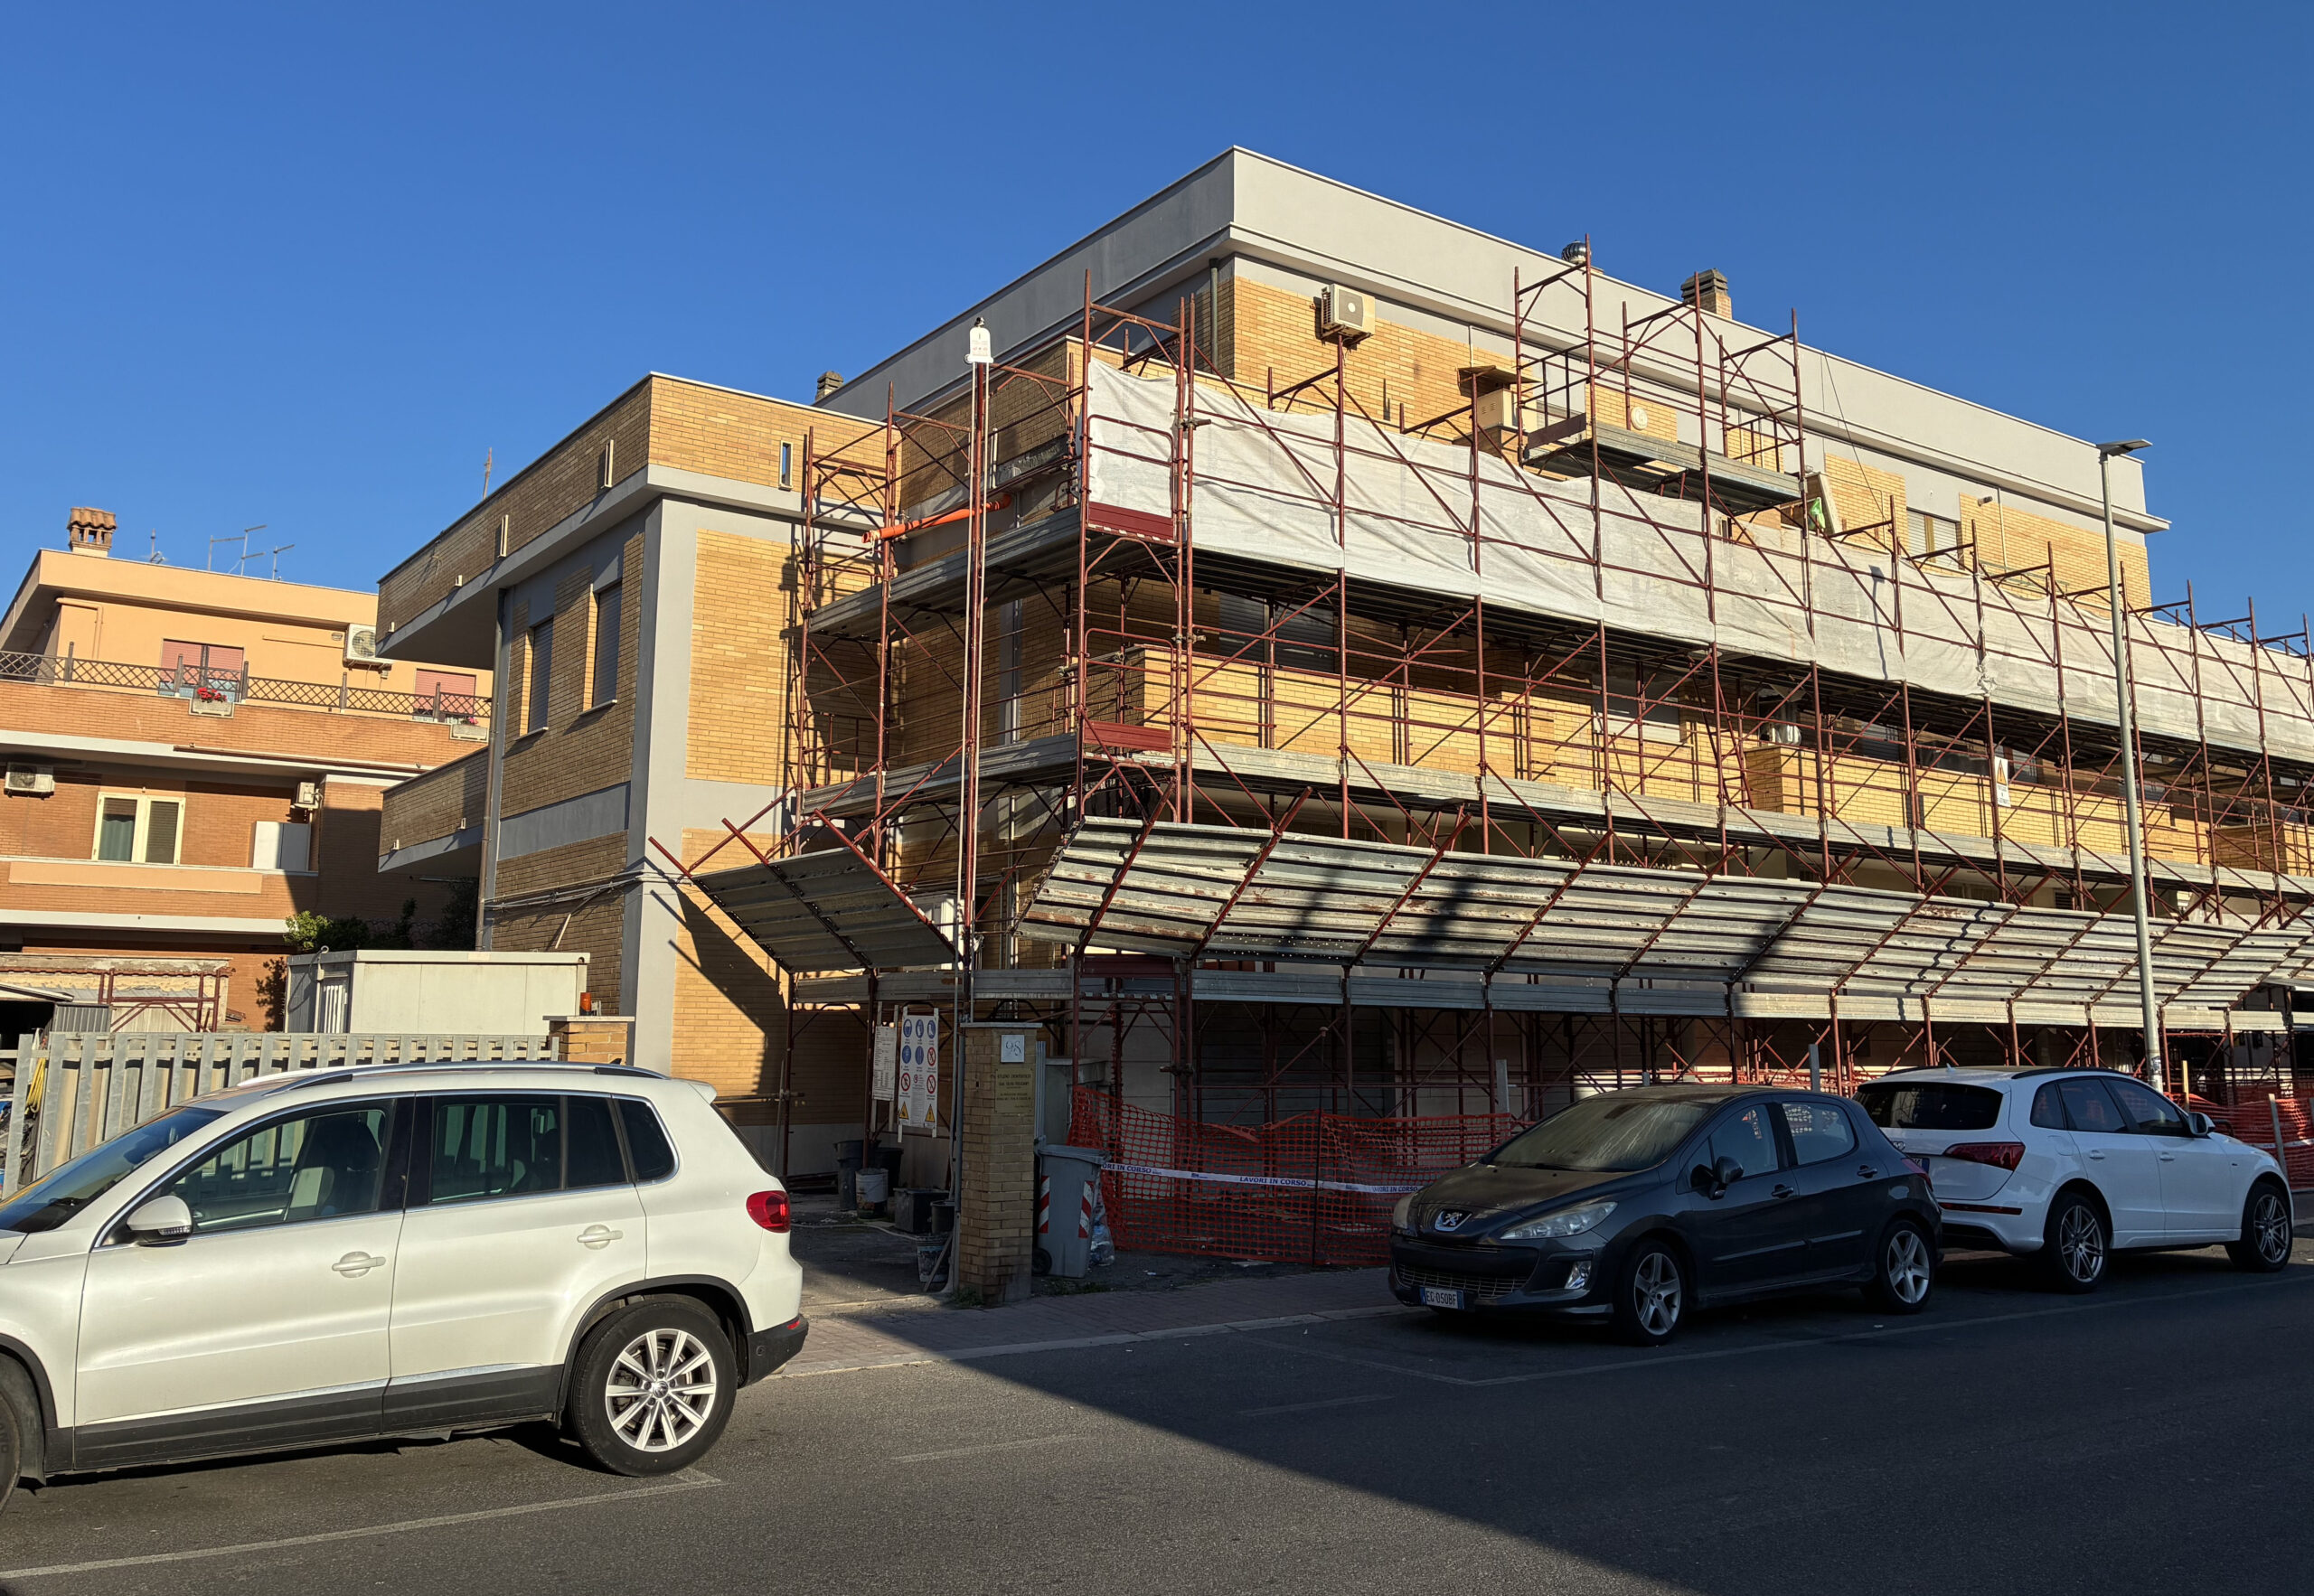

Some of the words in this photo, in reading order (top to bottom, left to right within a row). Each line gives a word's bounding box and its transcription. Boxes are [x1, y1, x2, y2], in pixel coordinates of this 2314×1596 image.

[1126, 1165, 1152, 1174] CORSO
[1239, 1176, 1267, 1184] LAVORI
[1280, 1178, 1307, 1187] CORSO
